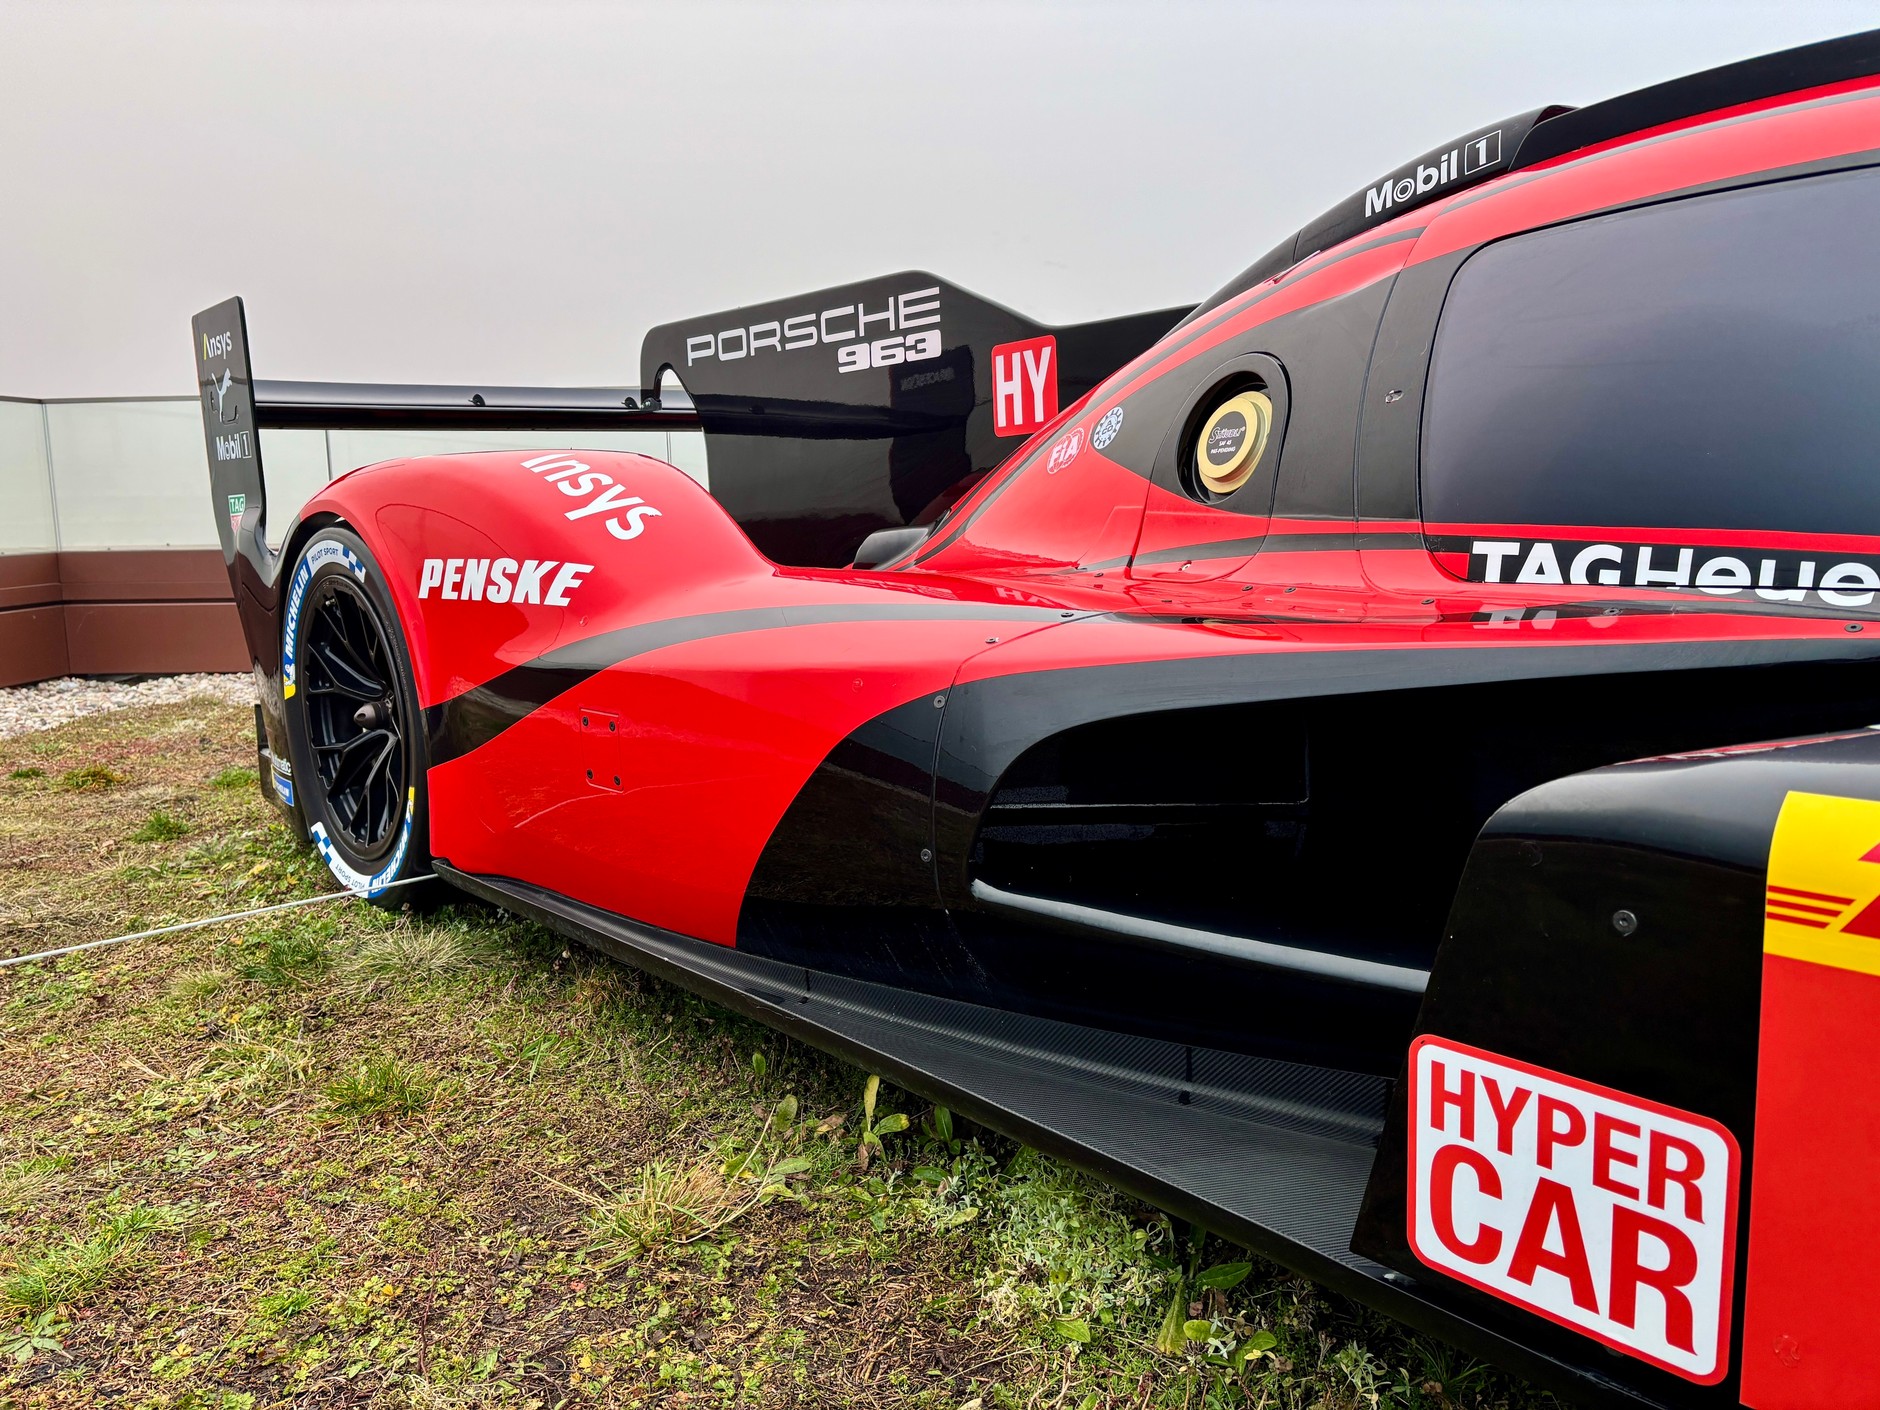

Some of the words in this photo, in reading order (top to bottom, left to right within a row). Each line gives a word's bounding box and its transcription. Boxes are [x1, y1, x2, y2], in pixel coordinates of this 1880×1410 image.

[1365, 149, 1458, 218] Mobil
[203, 331, 232, 360] Ansys
[686, 286, 941, 367] PORSCHE
[837, 329, 942, 374] 963
[995, 346, 1052, 428] HY
[216, 433, 241, 461] Mobil
[230, 498, 244, 513] TAG
[311, 549, 323, 564] PILOT
[323, 547, 339, 556] SPORT
[418, 558, 595, 607] PENSKE
[285, 563, 310, 660] MICHELIN
[1430, 1059, 1706, 1225] HYPER
[1429, 1143, 1699, 1357] CAR
